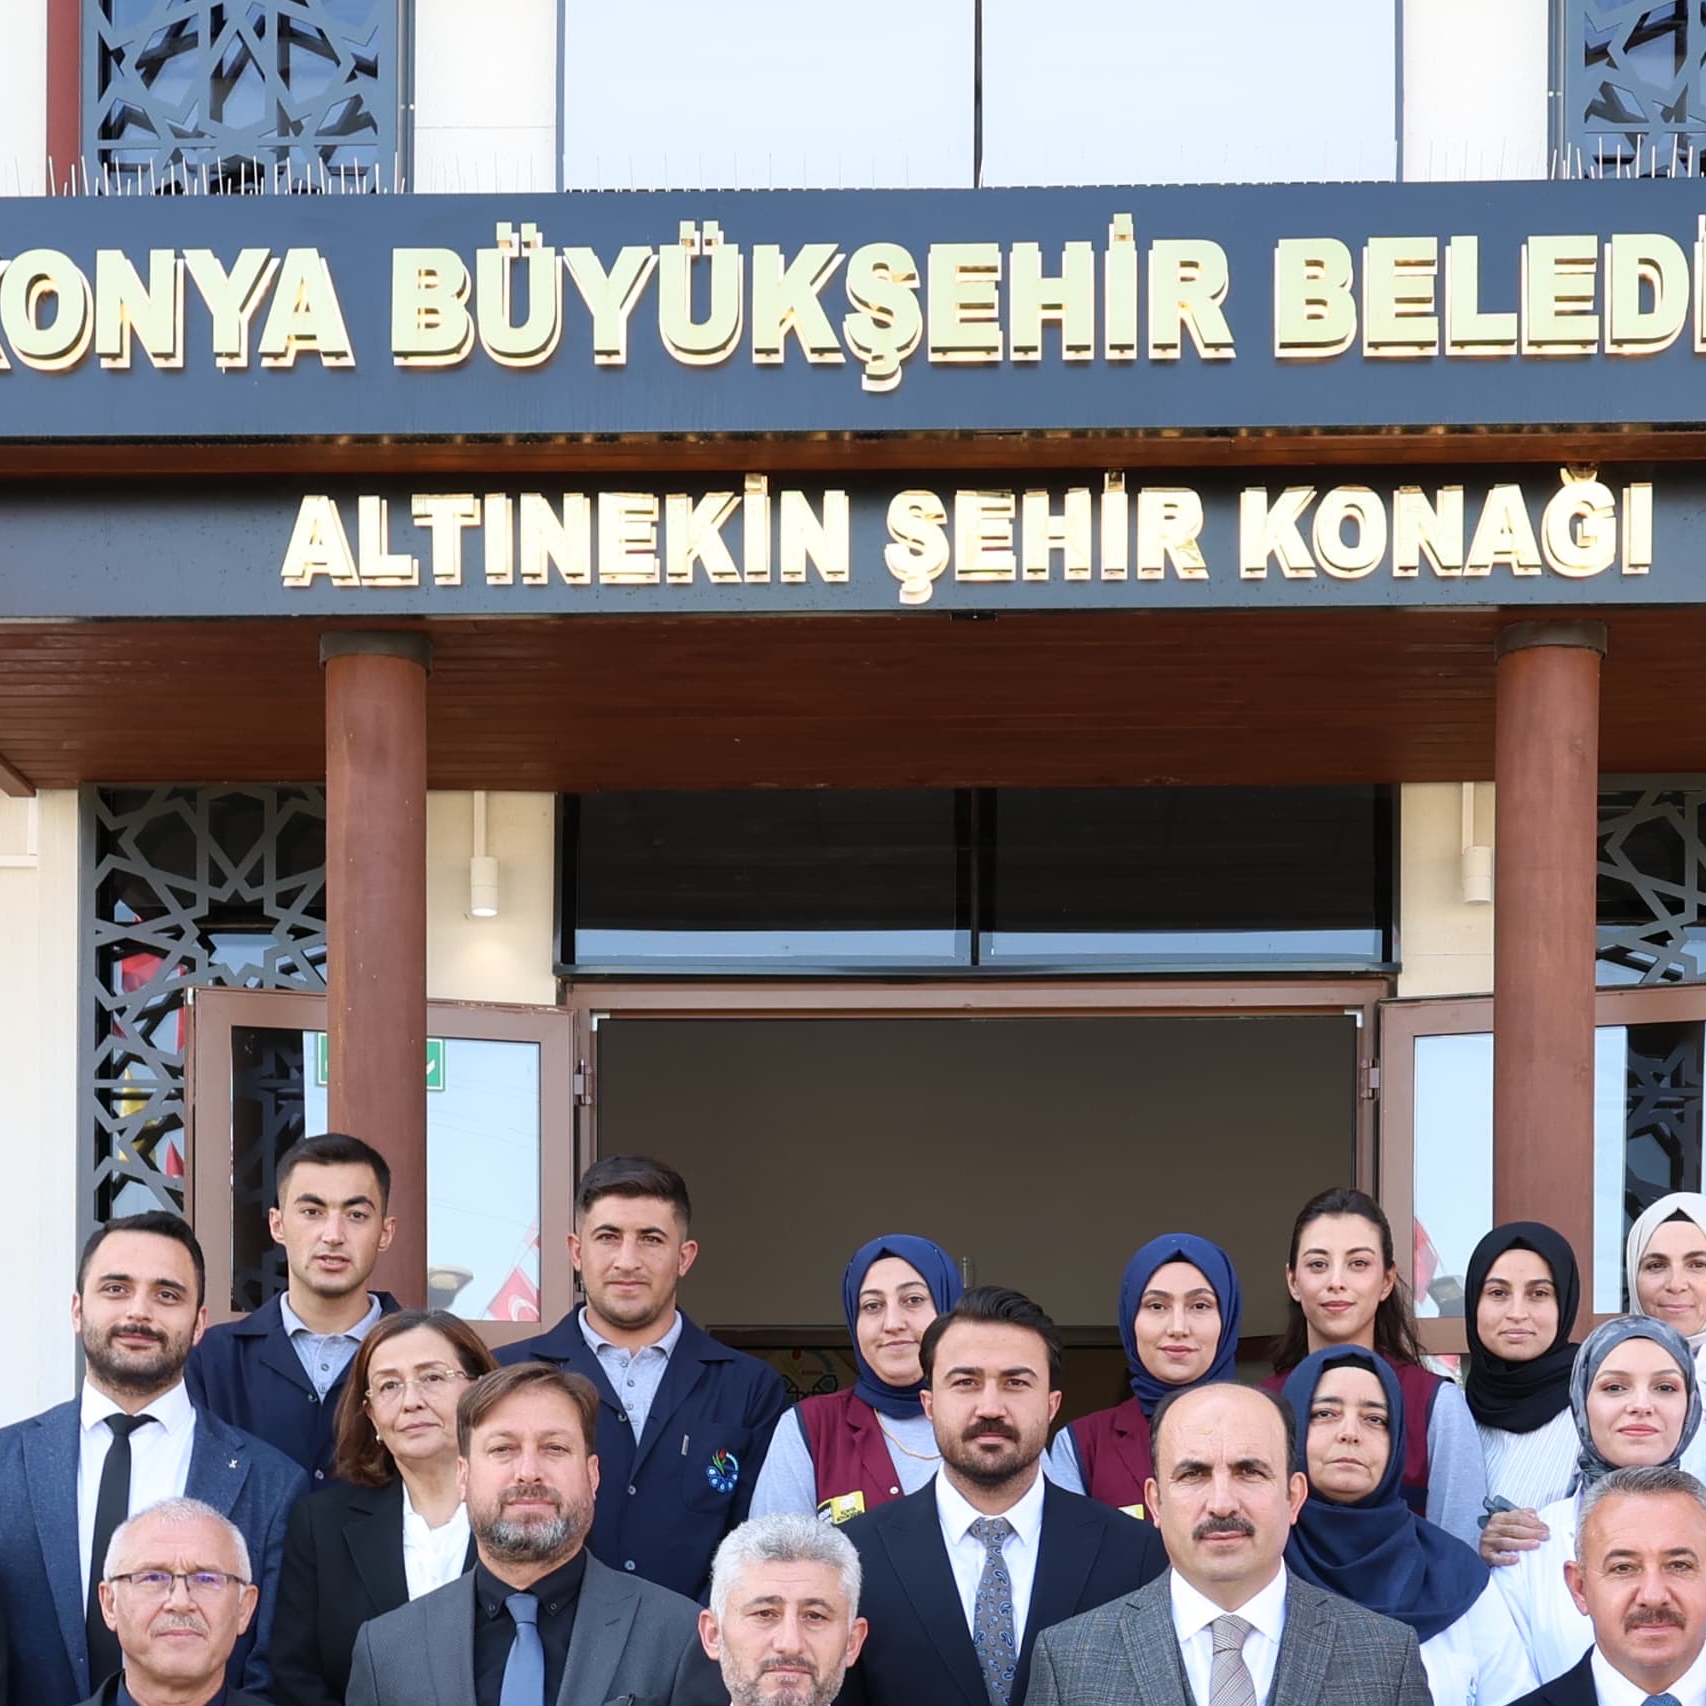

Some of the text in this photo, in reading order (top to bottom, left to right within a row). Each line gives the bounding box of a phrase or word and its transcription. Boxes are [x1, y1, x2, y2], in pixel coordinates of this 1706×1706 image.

[391, 212, 1237, 392] BÜYÜKŞEHİR
[281, 463, 1654, 605] ALTINEKİN ŞEHİR KONAĞI
